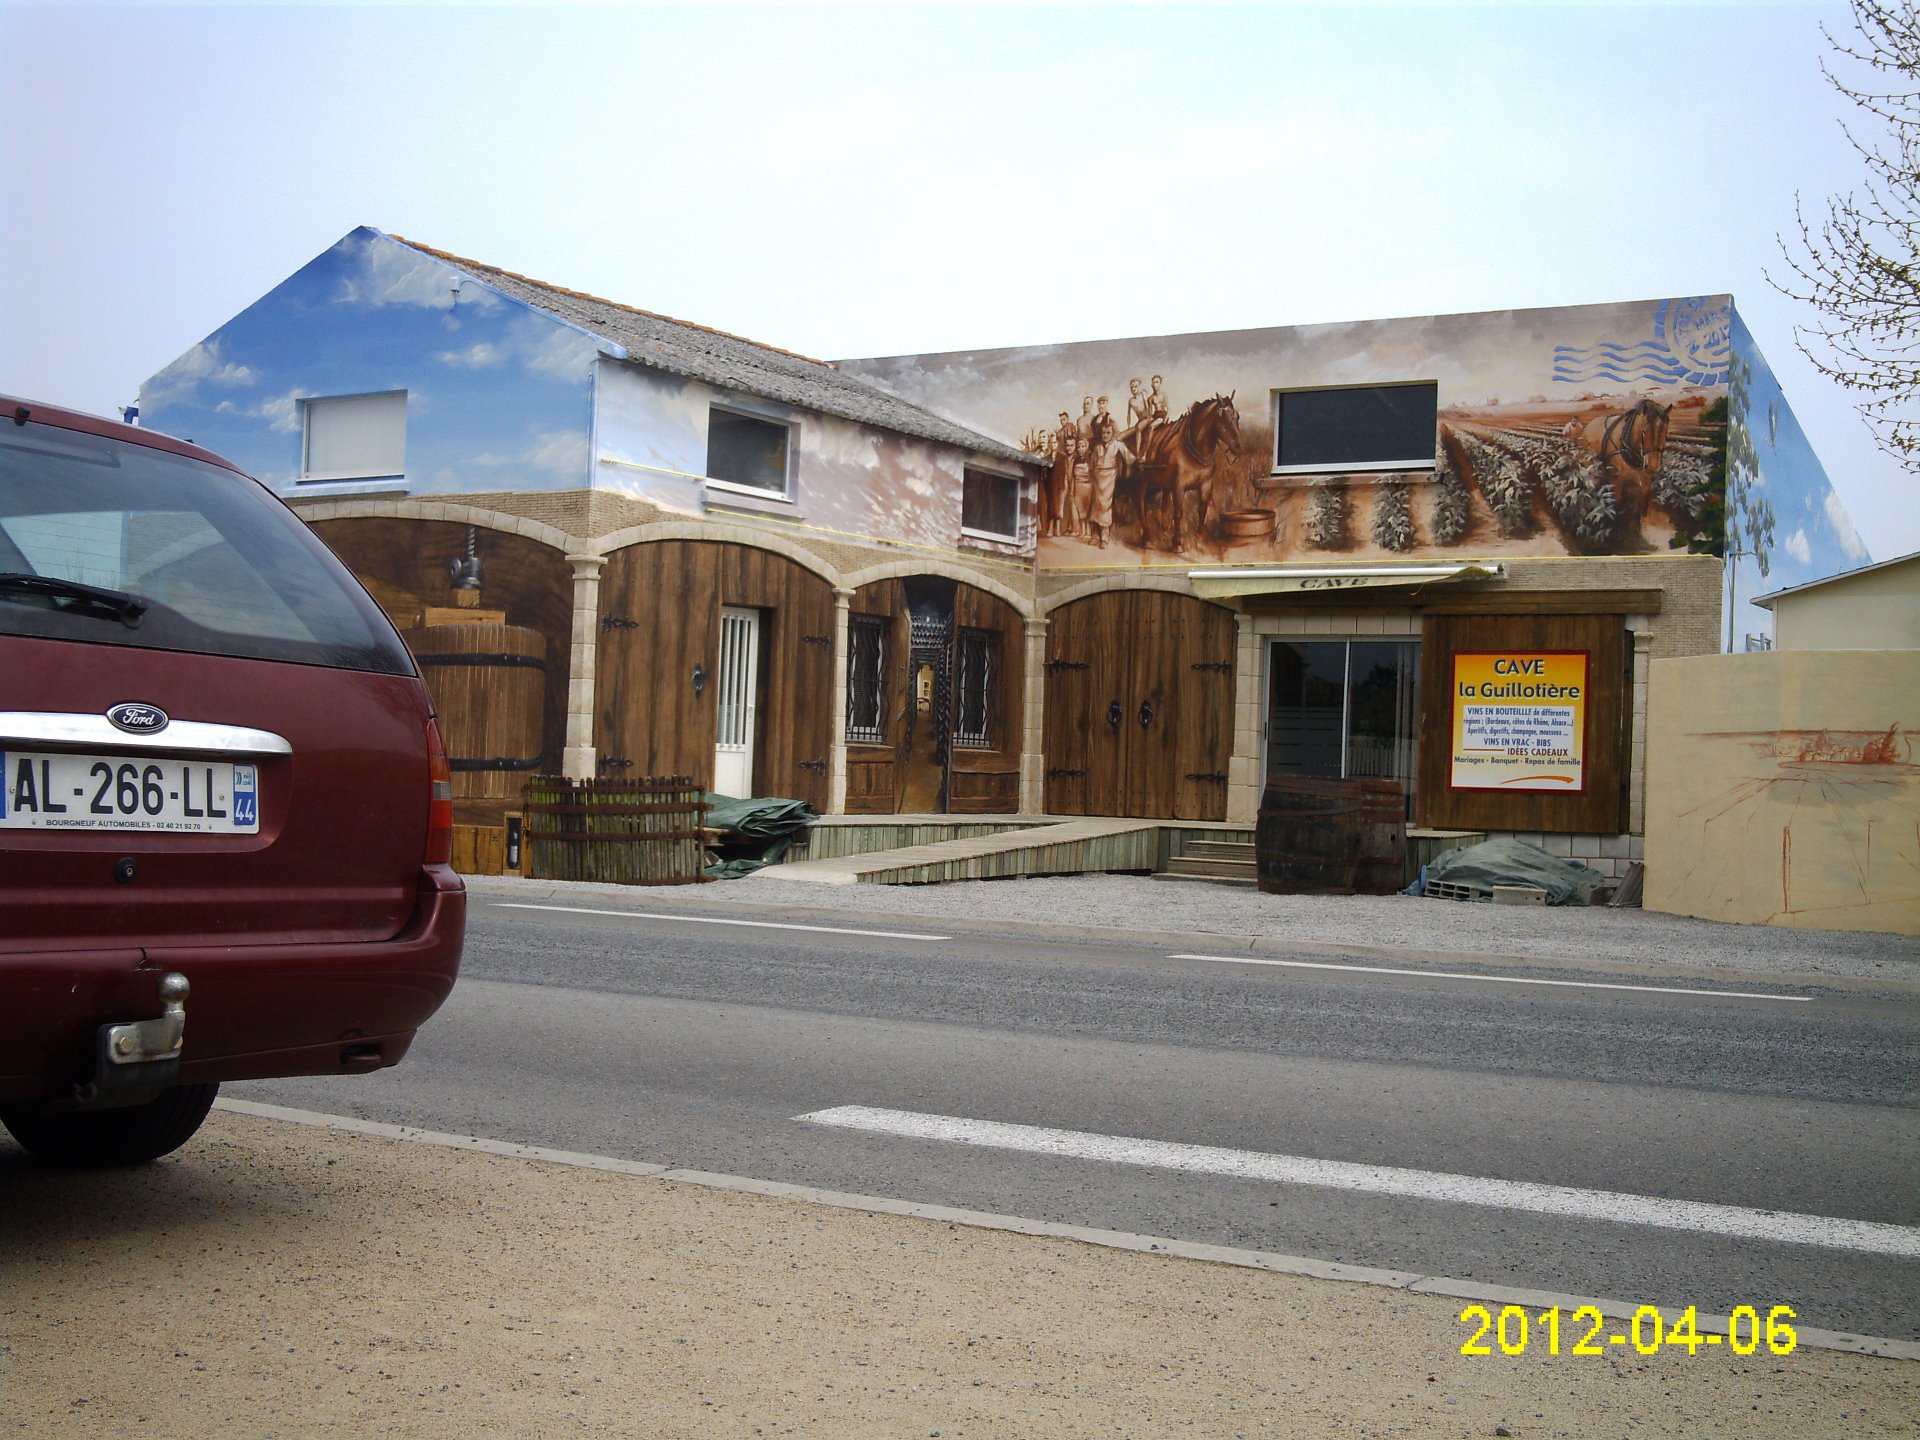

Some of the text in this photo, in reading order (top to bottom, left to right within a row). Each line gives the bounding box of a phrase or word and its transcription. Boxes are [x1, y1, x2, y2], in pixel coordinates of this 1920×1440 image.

[1300, 577, 1368, 588] CAVE
[1494, 659, 1544, 675] CAVE
[1459, 682, 1580, 698] la Guillotière
[122, 708, 156, 727] Ford
[1508, 746, 1528, 756] IDÉES
[1454, 756, 1484, 764] Mariages
[235, 799, 254, 821] 44
